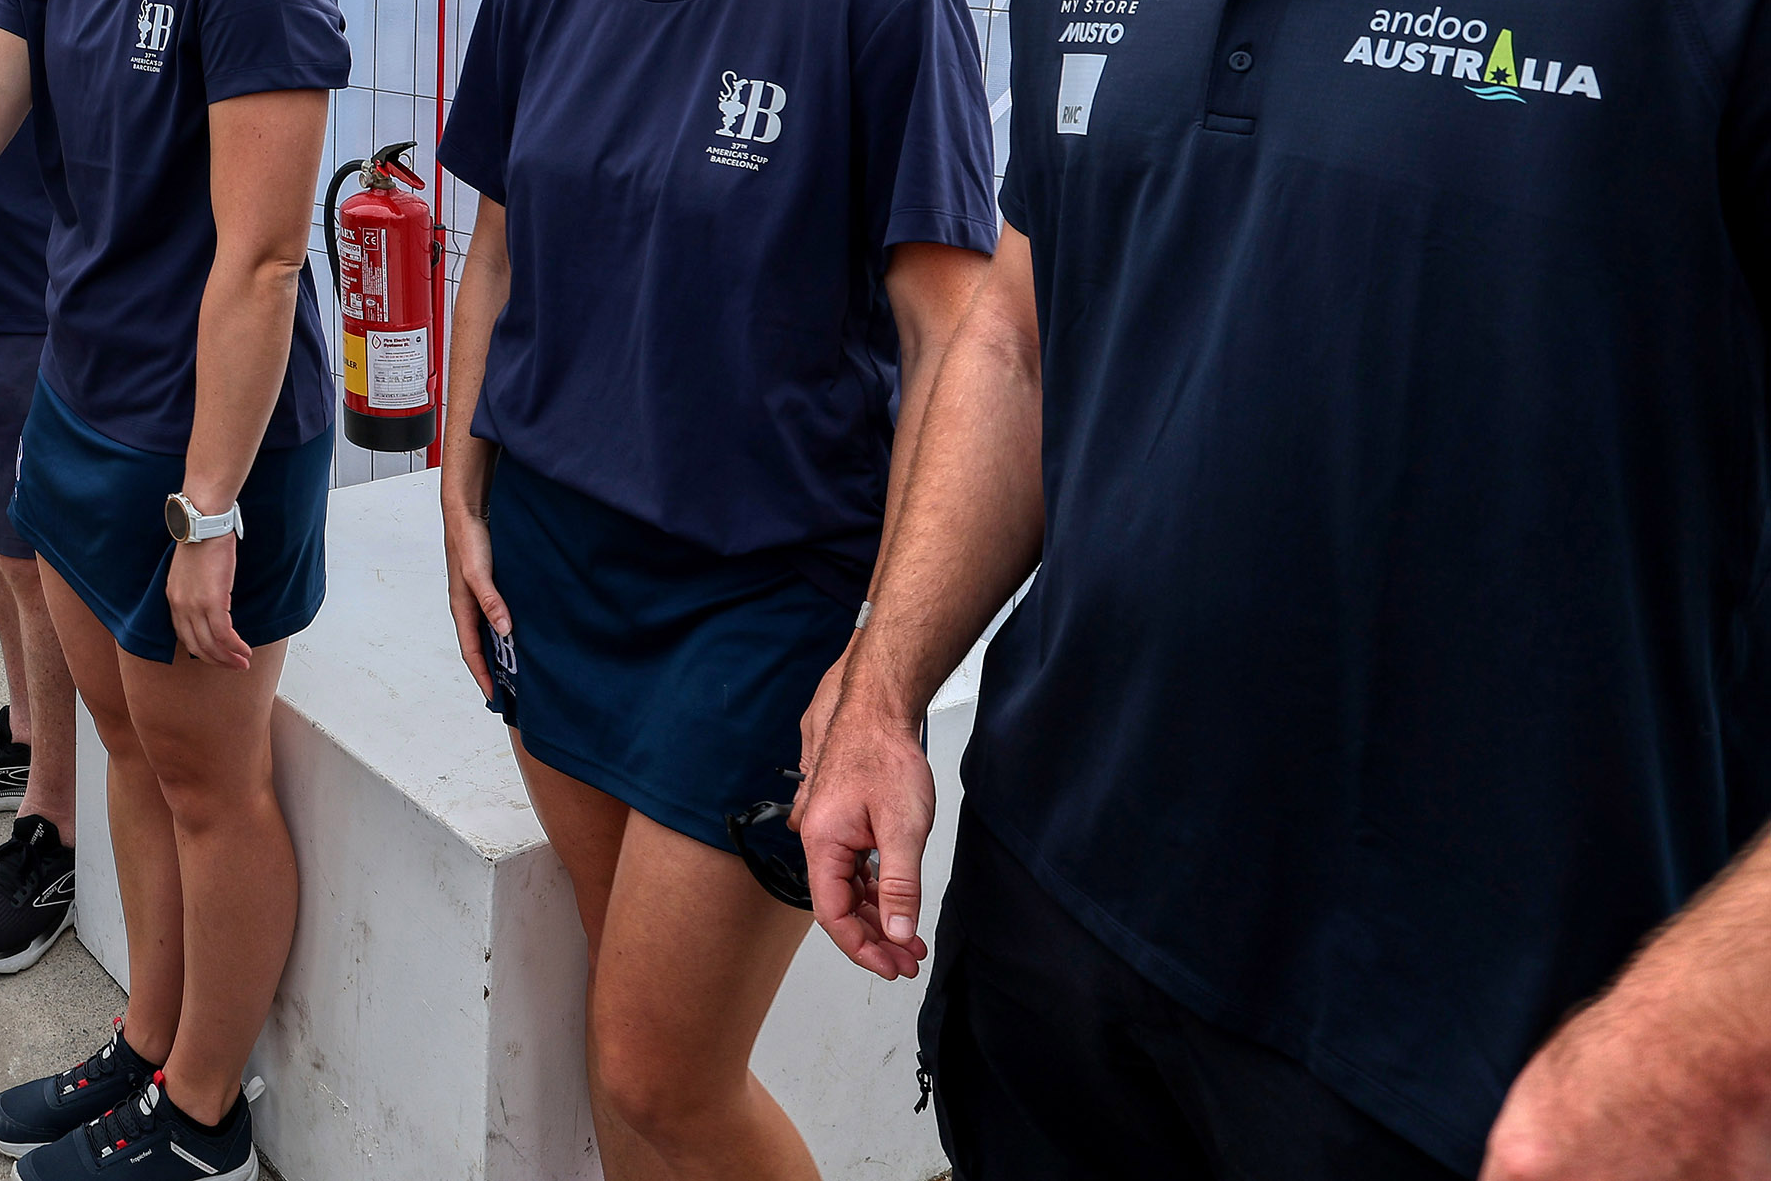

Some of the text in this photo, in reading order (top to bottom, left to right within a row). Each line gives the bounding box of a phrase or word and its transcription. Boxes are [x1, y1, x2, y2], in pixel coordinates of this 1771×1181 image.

[1060, 0, 1140, 15] MY STORE
[1058, 22, 1126, 45] MUSTO
[1369, 6, 1488, 45] andoo
[130, 56, 158, 67] AMERICA'S
[1342, 28, 1602, 101] AUSTRALIA
[705, 146, 769, 166] AMERICA'S CUP
[709, 155, 760, 172] BARCELONA
